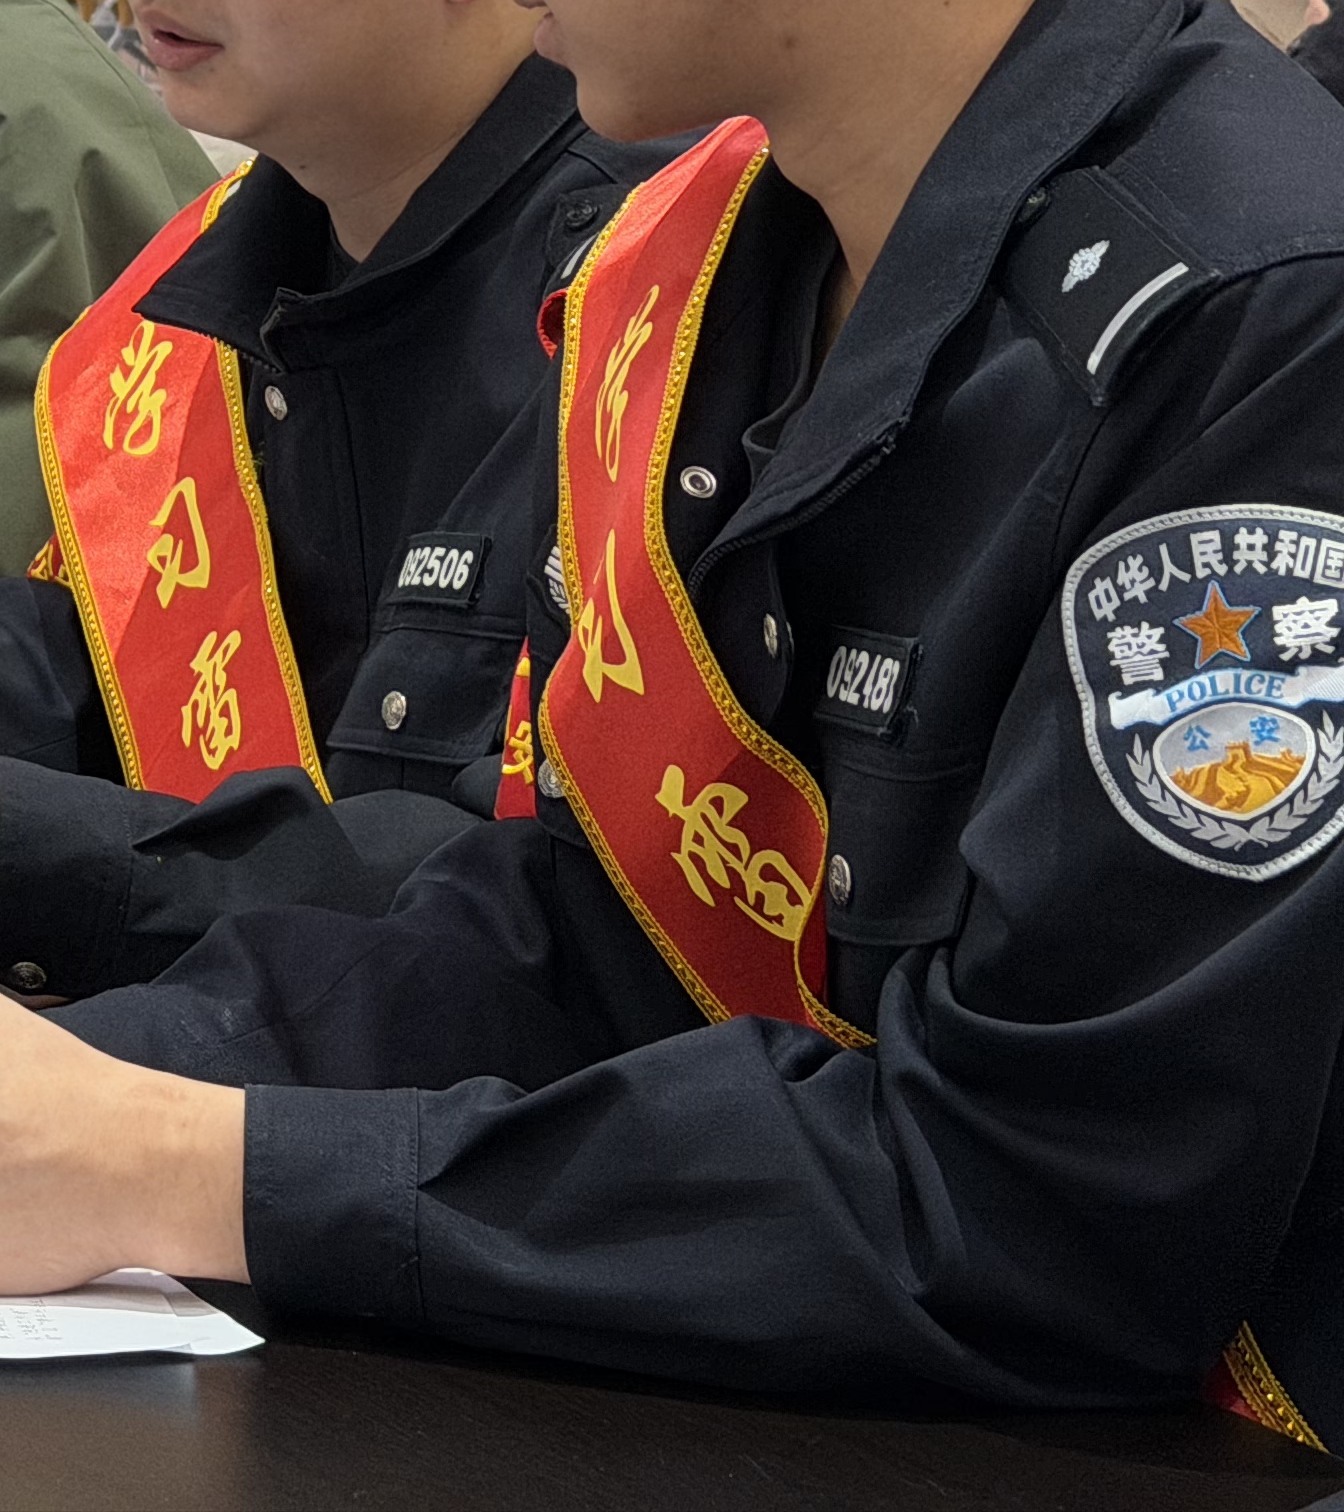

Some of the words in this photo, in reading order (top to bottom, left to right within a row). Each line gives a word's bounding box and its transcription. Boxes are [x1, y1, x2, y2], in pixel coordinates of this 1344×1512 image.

[398, 546, 474, 590] 092506
[1088, 527, 1344, 622] 中华人民共和国
[827, 645, 900, 714] 092481
[1165, 674, 1286, 723] POLICE
